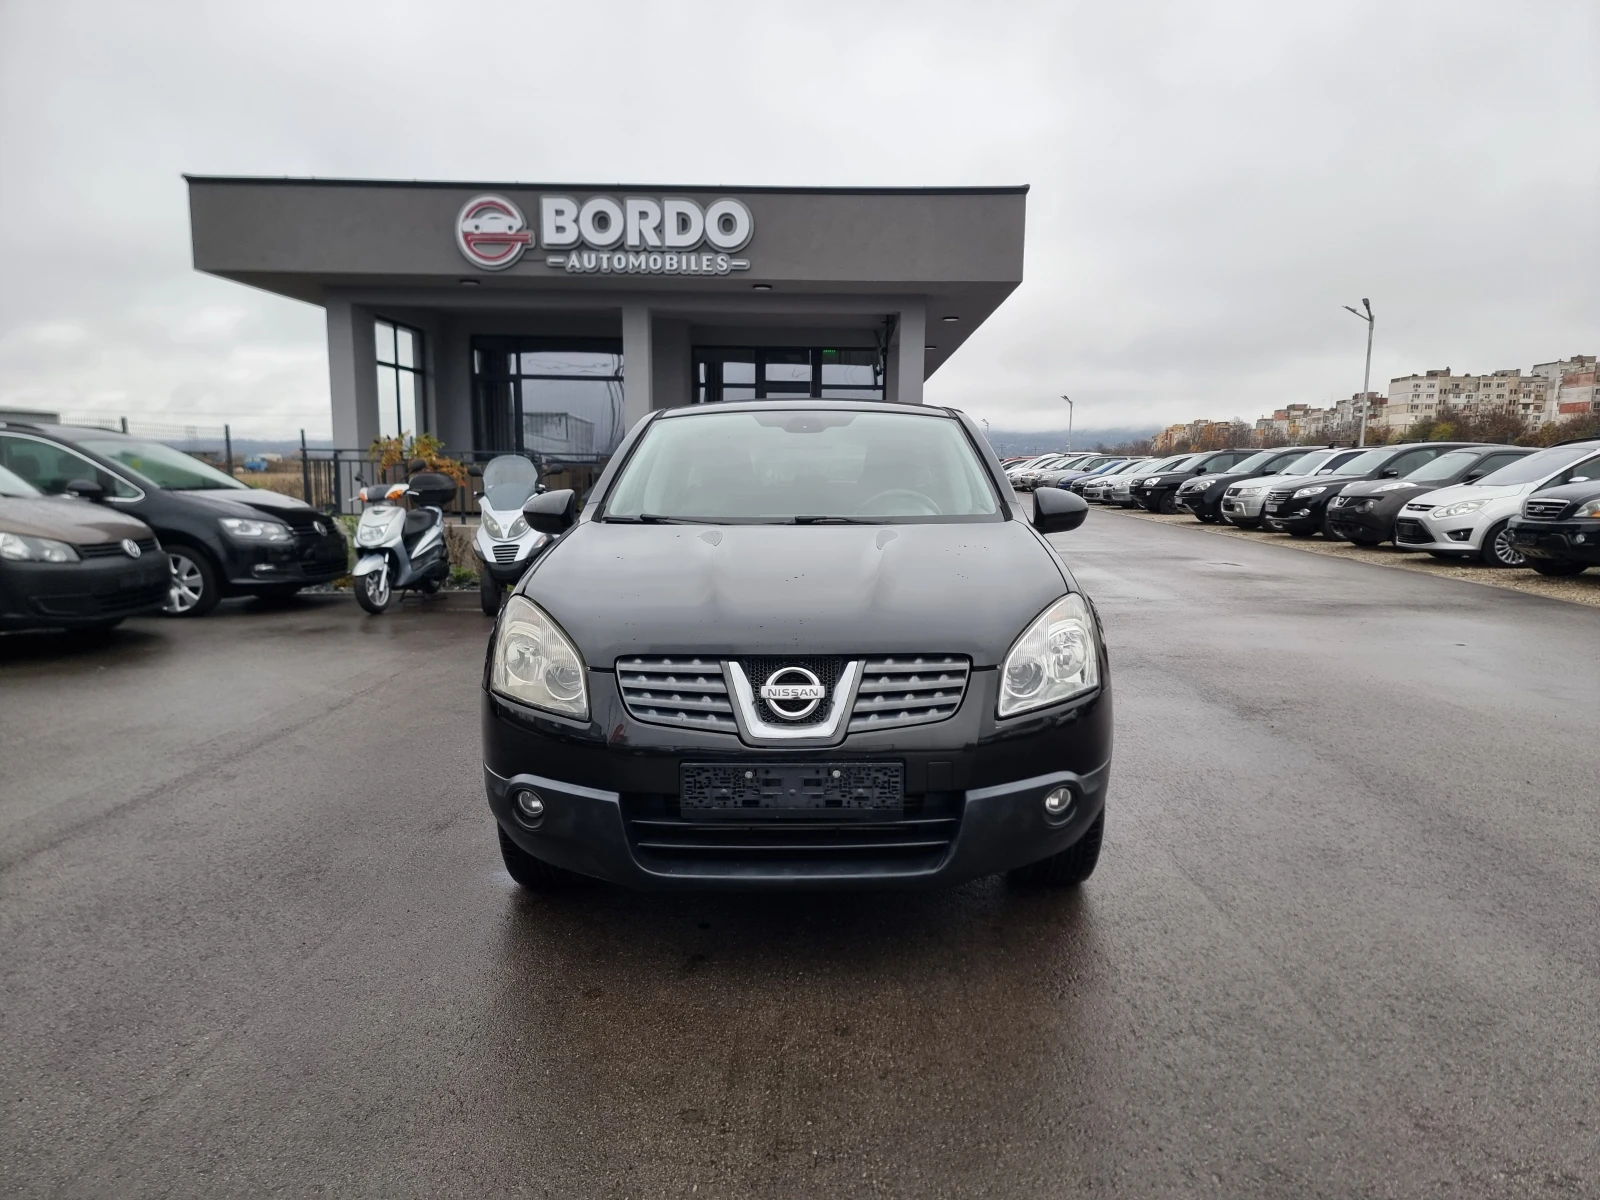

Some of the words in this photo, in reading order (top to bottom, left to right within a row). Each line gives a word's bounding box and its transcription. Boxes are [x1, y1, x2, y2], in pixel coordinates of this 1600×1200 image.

[541, 197, 750, 248] BORDO
[567, 252, 728, 271] AUTOMOBILES
[767, 688, 819, 697] NISSAN
